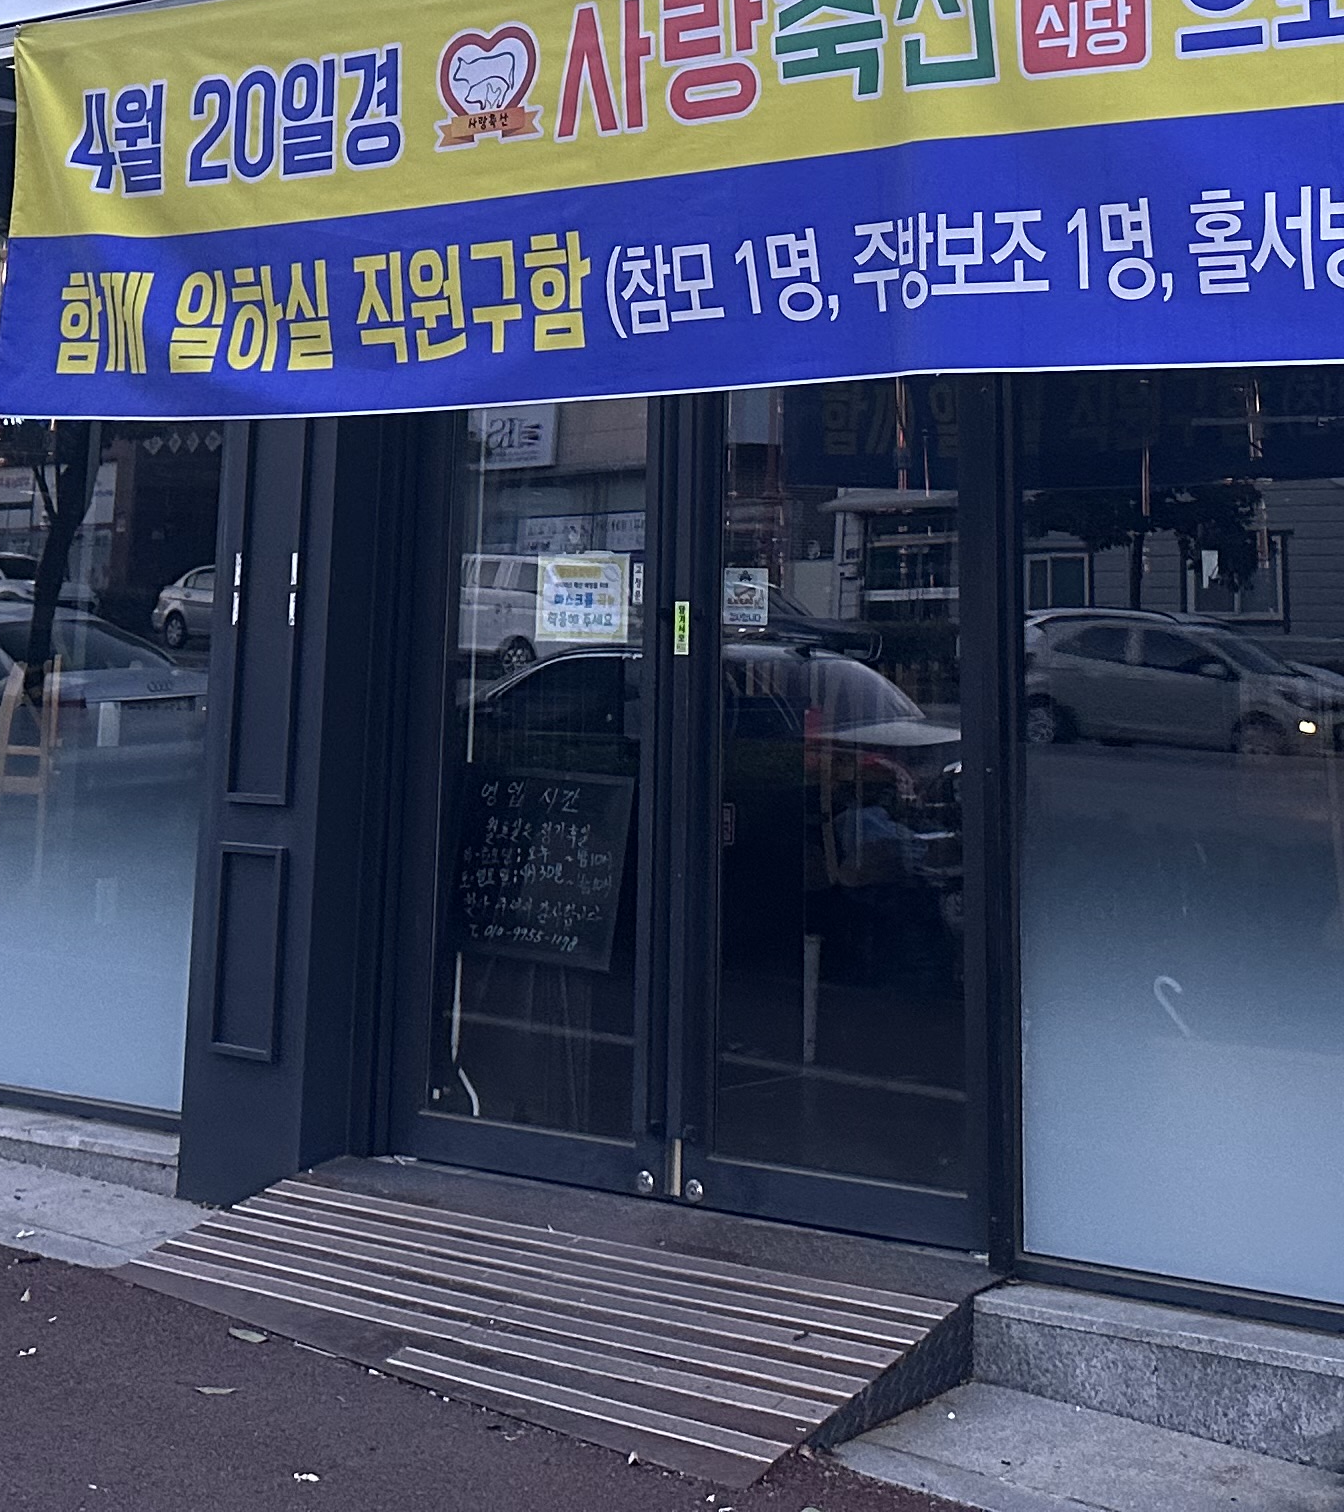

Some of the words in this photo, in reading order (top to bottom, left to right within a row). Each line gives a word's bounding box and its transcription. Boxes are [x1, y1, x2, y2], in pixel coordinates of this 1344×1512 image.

[68, 80, 167, 198] 4월
[187, 46, 403, 186] 20일경
[468, 113, 509, 130] 사랑축산
[55, 266, 149, 376] 함께
[169, 259, 332, 376] 일하실
[354, 229, 591, 354] 직원구함
[604, 241, 718, 341] (참모
[735, 229, 842, 324] 1명,
[853, 206, 1050, 315] 주방보조
[1065, 198, 1173, 304] 1명,
[554, 592, 593, 608] 마스크를
[481, 781, 524, 807] 영업
[540, 787, 581, 814] 시간
